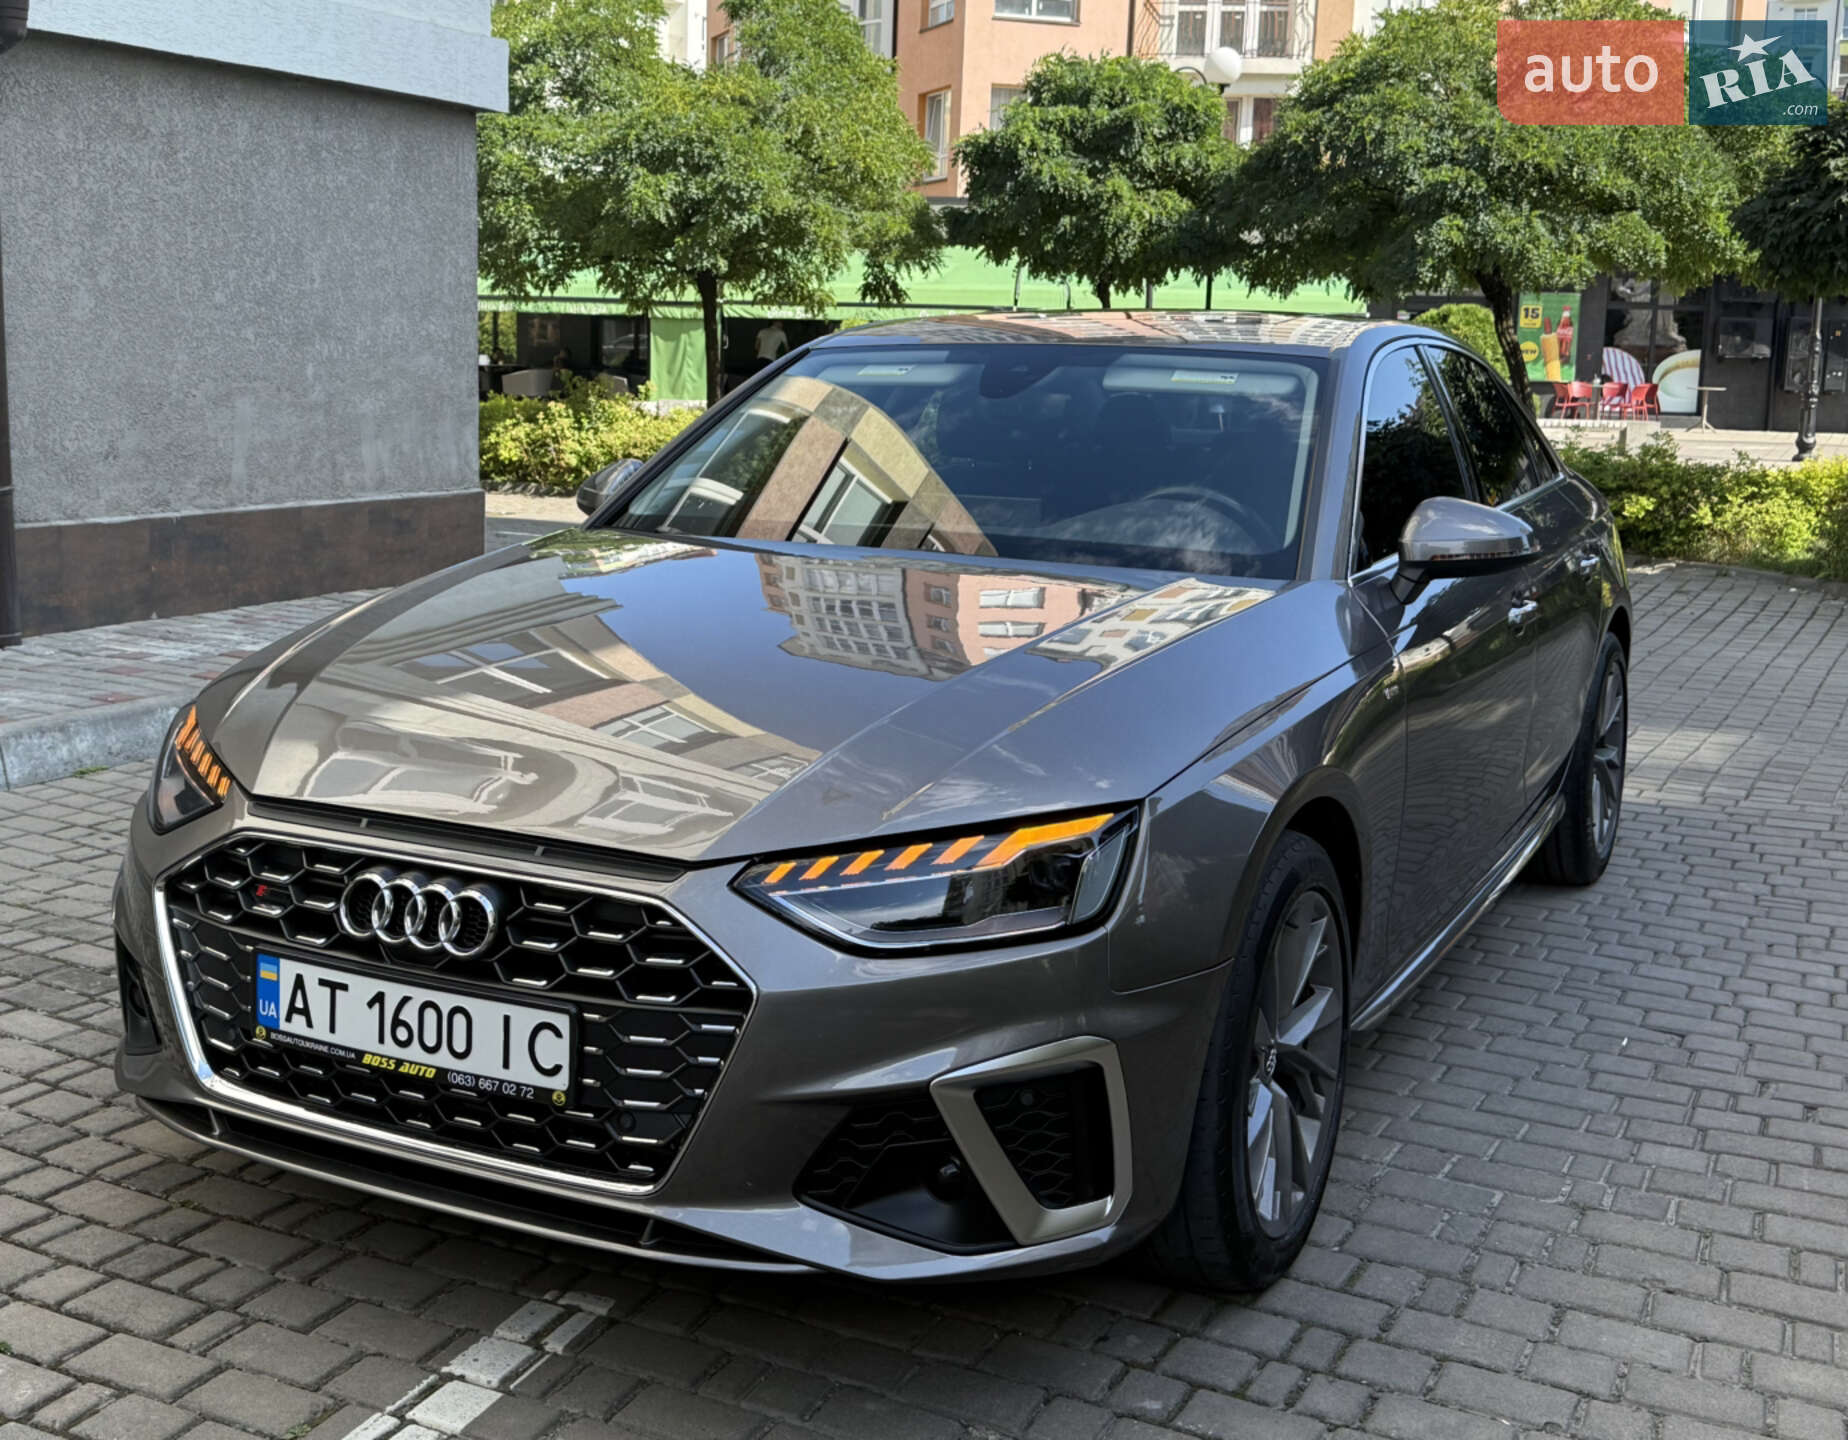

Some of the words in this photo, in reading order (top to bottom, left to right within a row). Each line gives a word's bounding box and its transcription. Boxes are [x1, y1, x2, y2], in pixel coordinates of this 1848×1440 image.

[1523, 307, 1540, 319] 15
[259, 1000, 278, 1020] UA
[285, 973, 349, 1034] AT
[366, 991, 473, 1060] 1600
[502, 1014, 564, 1077] IC
[362, 1053, 397, 1070] BOSS
[399, 1062, 437, 1079] AUTO
[447, 1071, 476, 1088] (063)
[478, 1078, 499, 1092] 667
[502, 1083, 517, 1095] 02
[520, 1086, 535, 1099] 72
